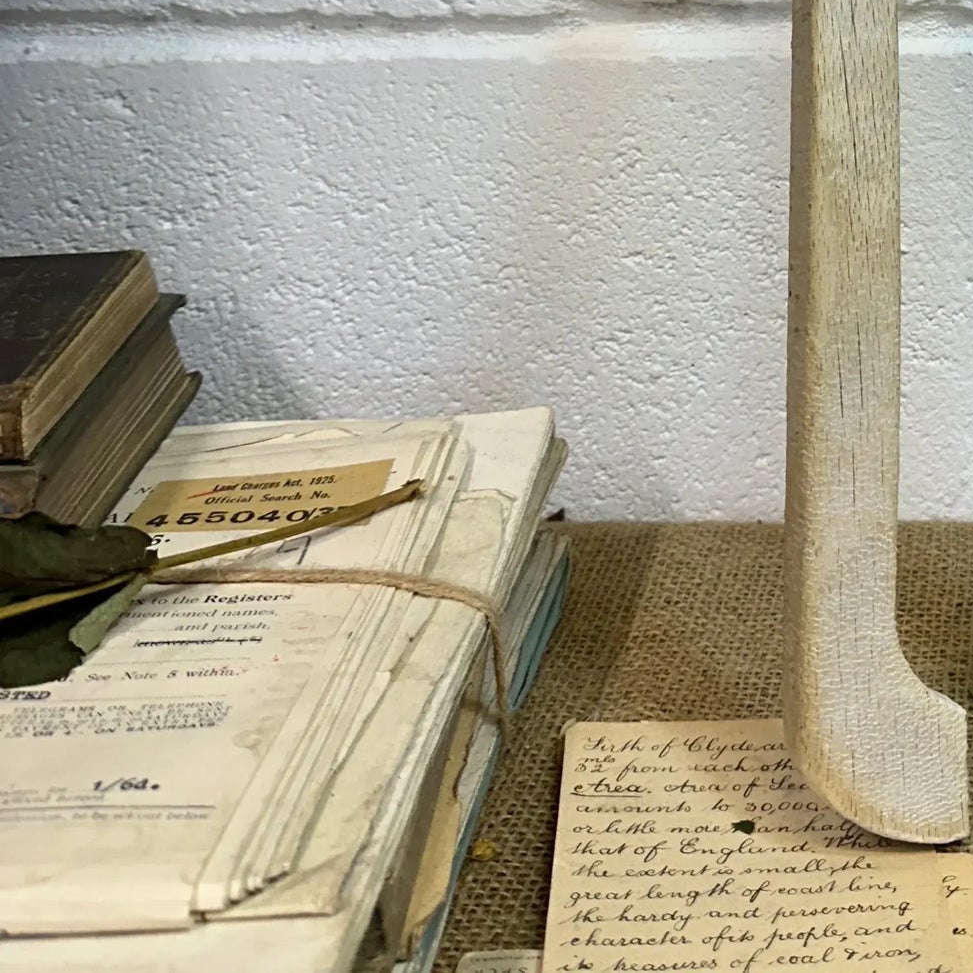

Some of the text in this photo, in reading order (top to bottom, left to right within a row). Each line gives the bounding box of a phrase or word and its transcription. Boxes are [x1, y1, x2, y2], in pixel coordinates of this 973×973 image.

[212, 483, 238, 492] Land
[241, 479, 281, 491] Charges
[283, 477, 305, 488] Act,
[204, 490, 332, 505] Official Search No.
[151, 595, 169, 605] to
[172, 594, 200, 604] the
[203, 593, 294, 604] Registers
[174, 622, 209, 631] and
[87, 672, 112, 682] See
[121, 670, 159, 681] Note
[651, 736, 679, 758] of
[616, 758, 678, 782] from
[689, 756, 749, 773] each
[664, 779, 725, 793] Area
[732, 777, 760, 797] of
[576, 801, 692, 813] amounts
[712, 798, 730, 812] to
[572, 825, 592, 834] or
[600, 820, 656, 835] little
[670, 824, 721, 834] more
[571, 841, 628, 856] that
[634, 840, 671, 863] of
[571, 859, 614, 878] the
[625, 865, 708, 877] extent
[712, 866, 733, 876] is
[840, 855, 873, 872] the
[564, 888, 634, 908] great
[640, 878, 735, 907] length
[741, 881, 771, 903] of
[773, 880, 837, 896] coast
[562, 895, 911, 931] the hardy and persevering
[560, 927, 692, 946] character
[854, 919, 916, 937] and
[558, 955, 594, 971] its
[730, 947, 766, 973] of
[769, 947, 836, 965] coal
